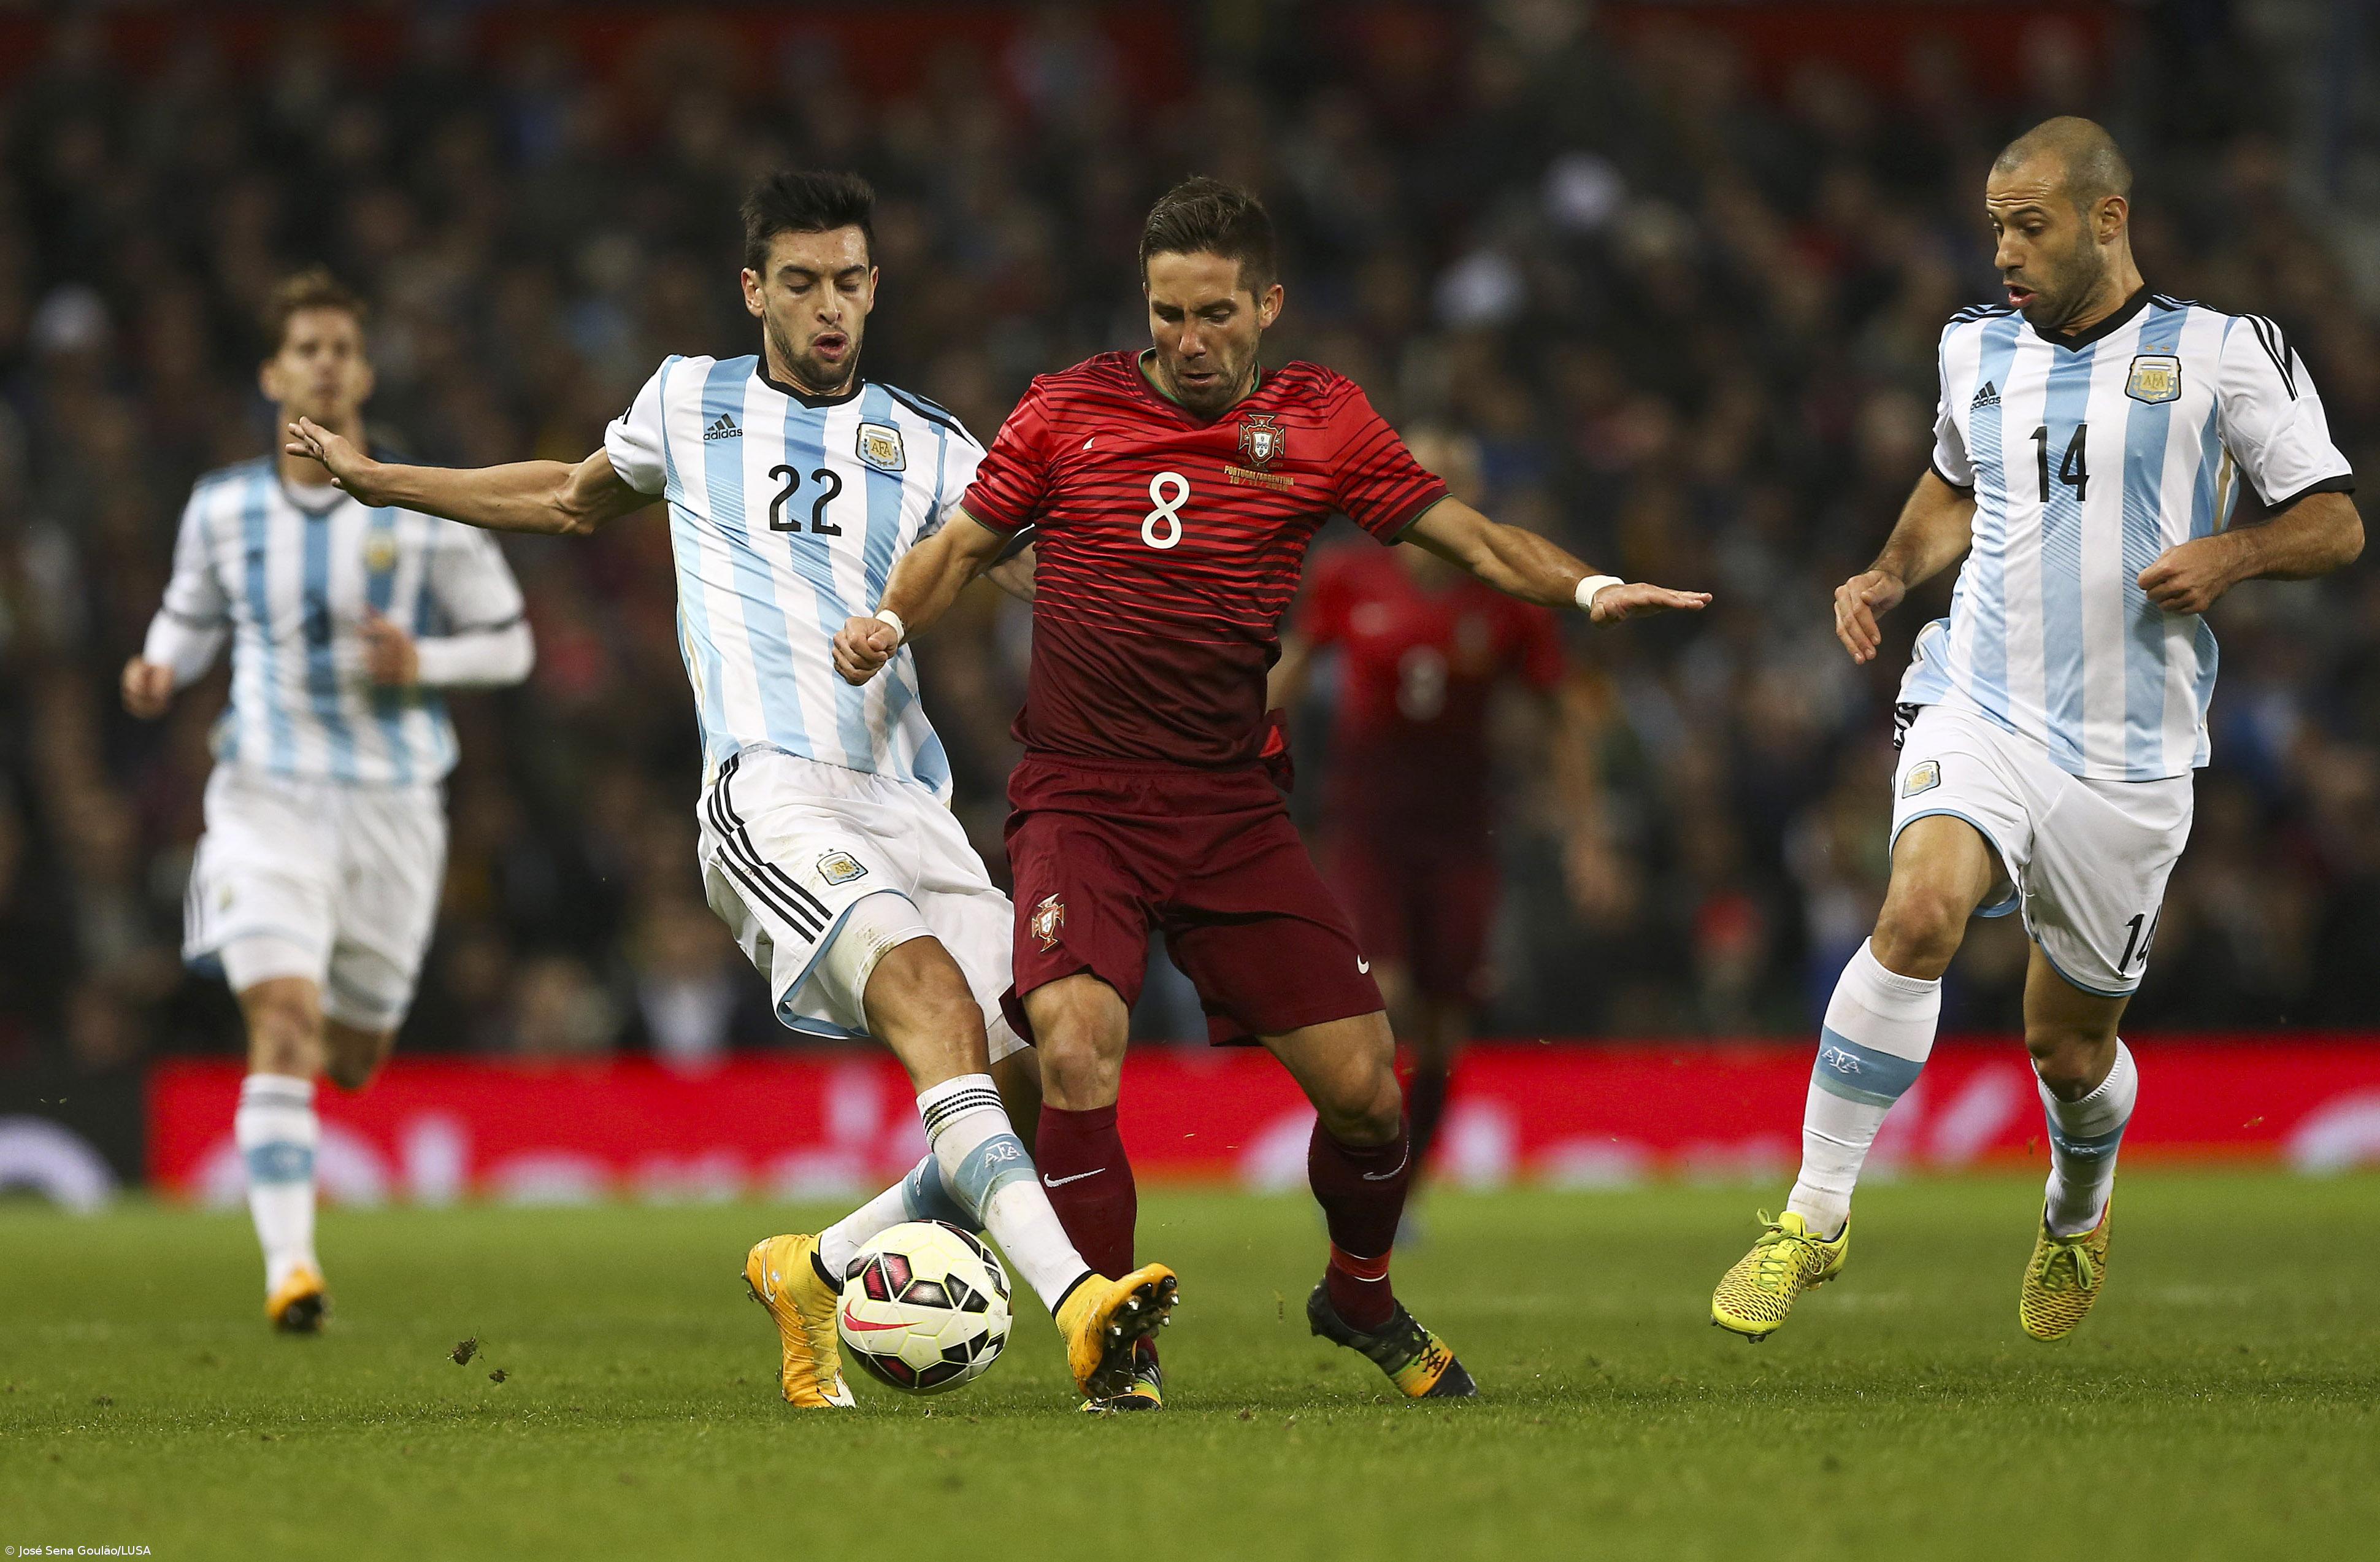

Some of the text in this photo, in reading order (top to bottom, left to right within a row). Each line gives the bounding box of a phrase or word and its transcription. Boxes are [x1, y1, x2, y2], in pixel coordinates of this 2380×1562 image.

[704, 429, 743, 440] adidas
[2029, 425, 2090, 502] 14
[768, 464, 842, 536] 22
[1141, 471, 1190, 549] 8
[2117, 905, 2160, 975] 14
